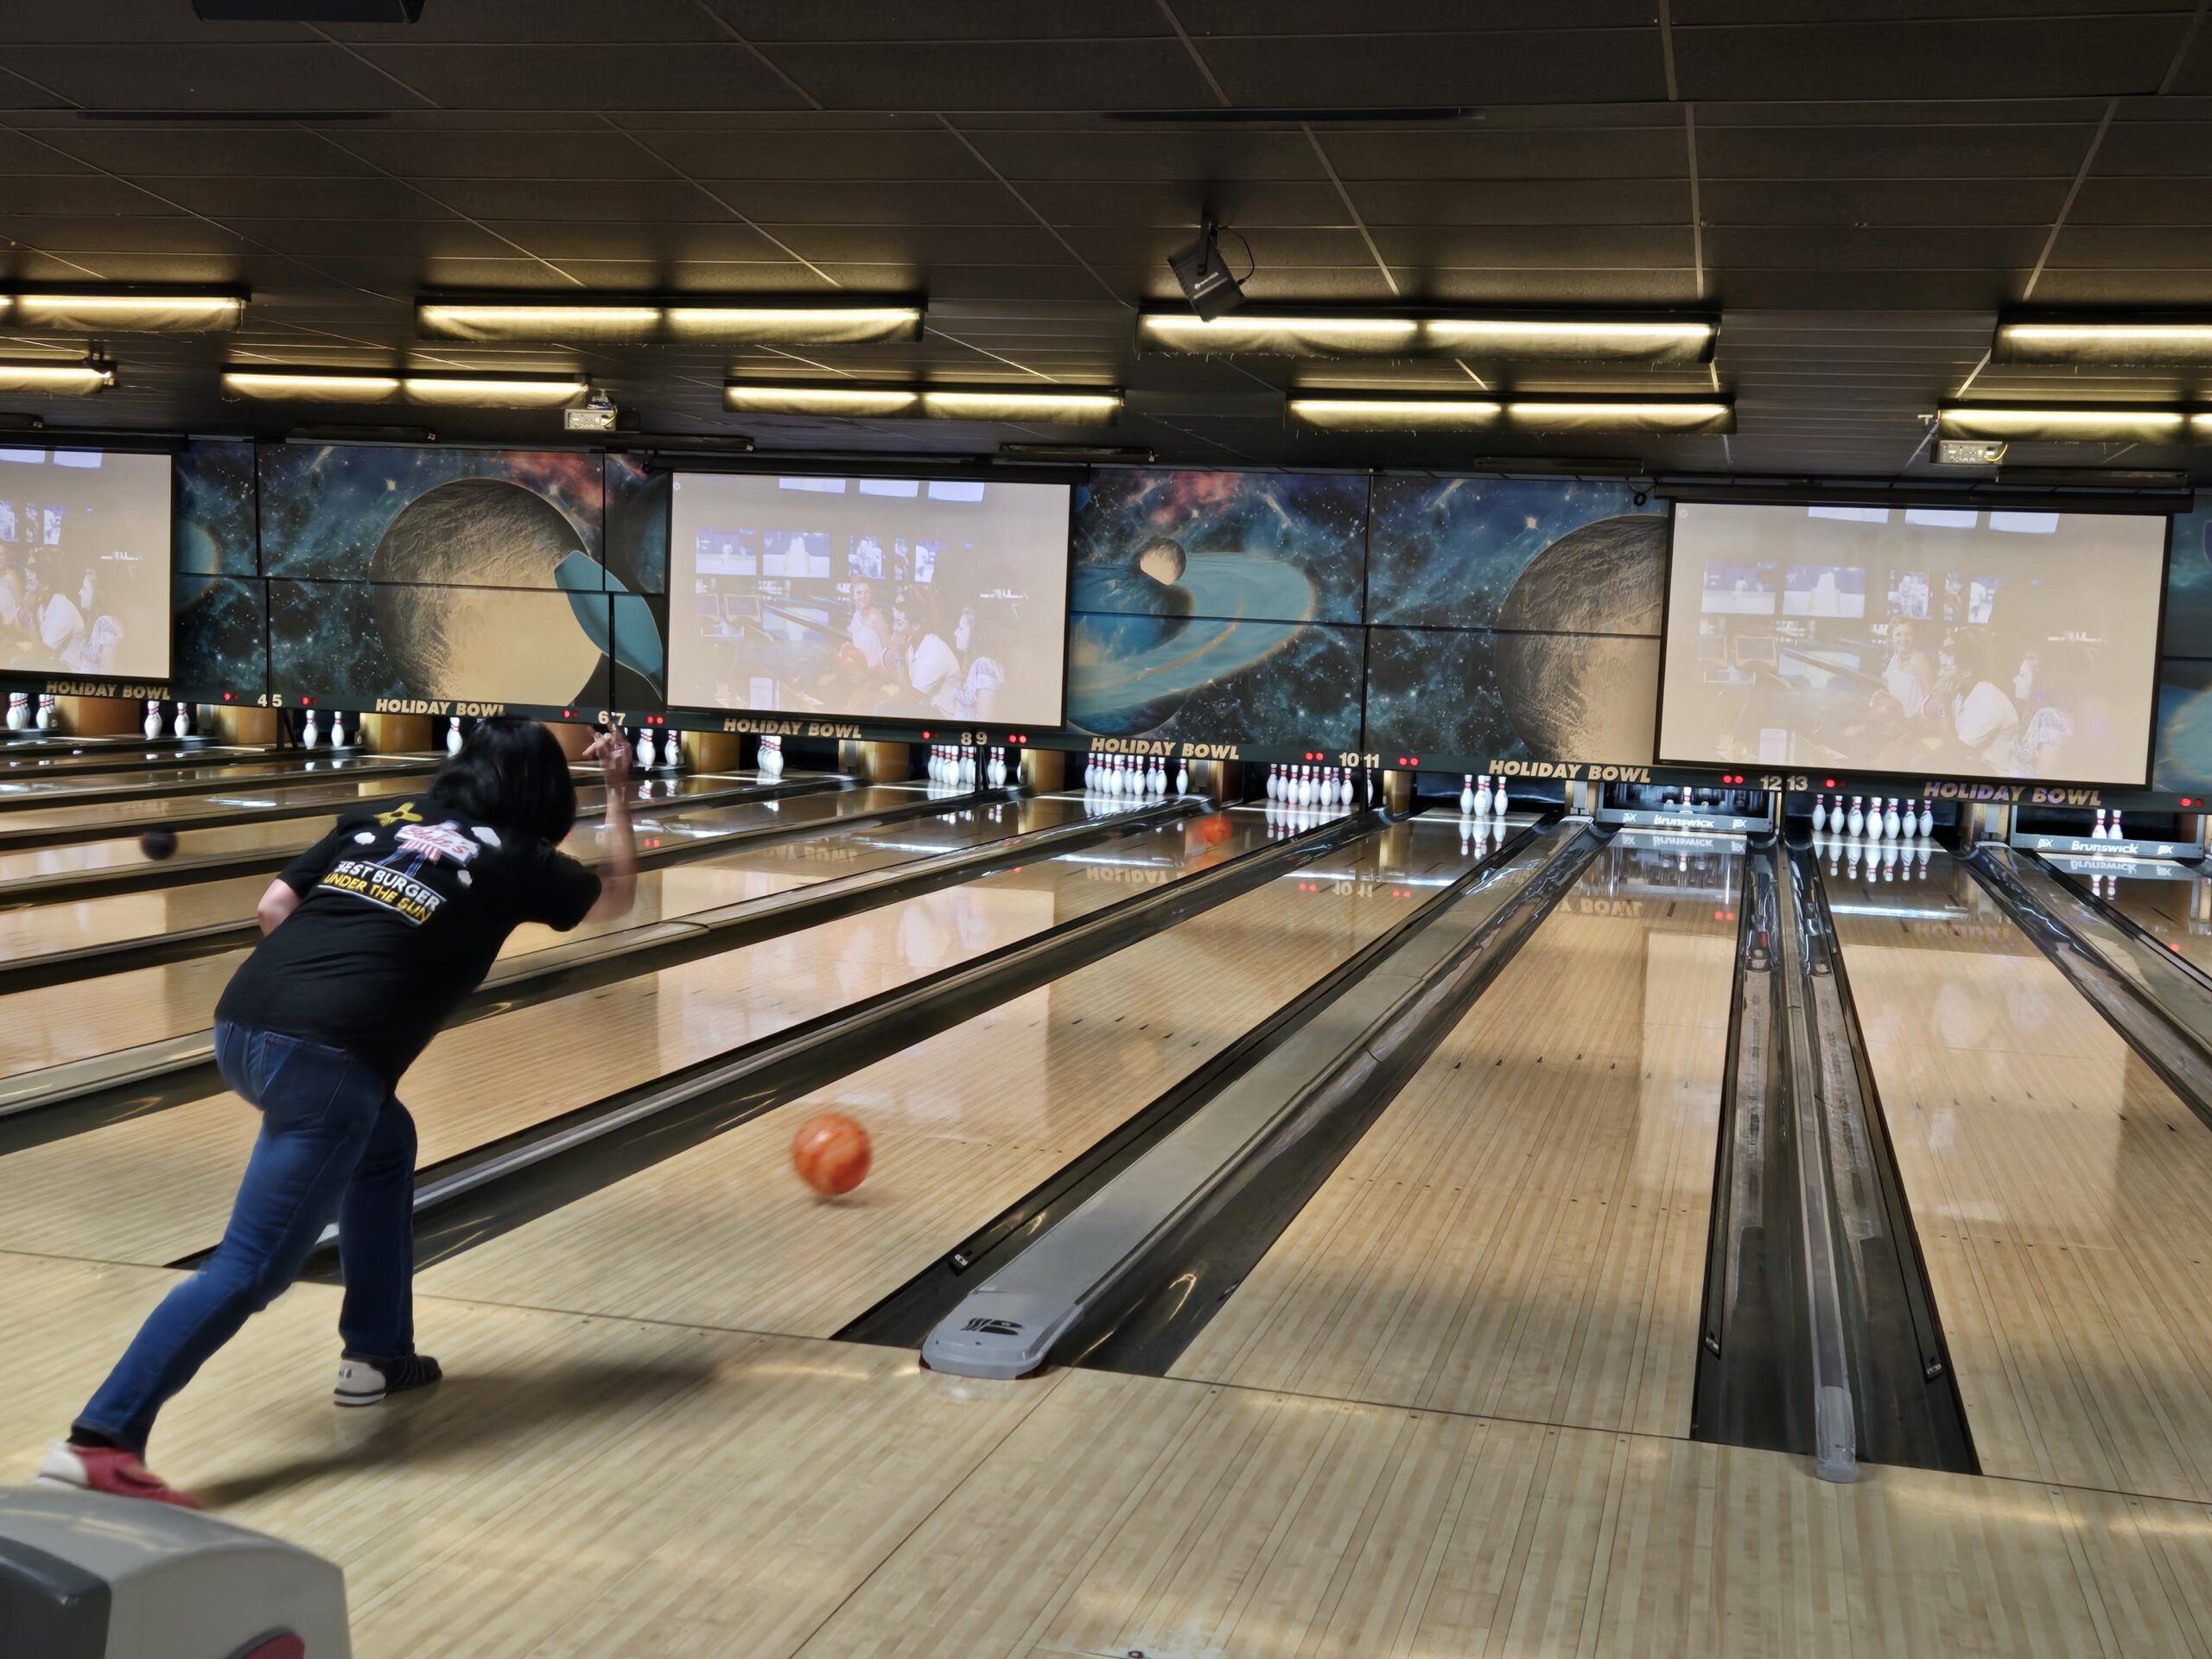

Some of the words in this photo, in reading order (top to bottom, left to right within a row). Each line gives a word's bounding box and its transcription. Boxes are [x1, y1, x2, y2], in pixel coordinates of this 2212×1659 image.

[46, 680, 118, 697] HOLIDAY
[123, 686, 170, 701] BOWL
[257, 694, 268, 707] 4
[272, 694, 283, 708] 5
[375, 698, 451, 715] HOLIDAY
[598, 710, 609, 725] 6
[615, 713, 626, 726] 7
[723, 718, 801, 736] HOLIDAY
[808, 722, 861, 740] BOWL
[961, 732, 973, 746] 8
[976, 731, 988, 746] 9
[1090, 737, 1176, 757] HOLIDAY
[1181, 742, 1239, 760] BOWL
[1339, 752, 1359, 767] 10
[1363, 752, 1380, 768] 11
[1488, 760, 1581, 779] HOLIDAY
[1587, 766, 1651, 784] BOWL
[1760, 776, 1783, 791] 12
[1787, 776, 1808, 791] 13
[1923, 781, 2028, 803] HOLIDAY
[2031, 786, 2101, 806] BOWL
[1654, 814, 1715, 828] Brunswick
[2071, 841, 2139, 854] Brunswick
[324, 872, 368, 892] UNDER
[370, 884, 397, 903] THE
[397, 898, 432, 924] SUN
[372, 869, 441, 912] BURGER
